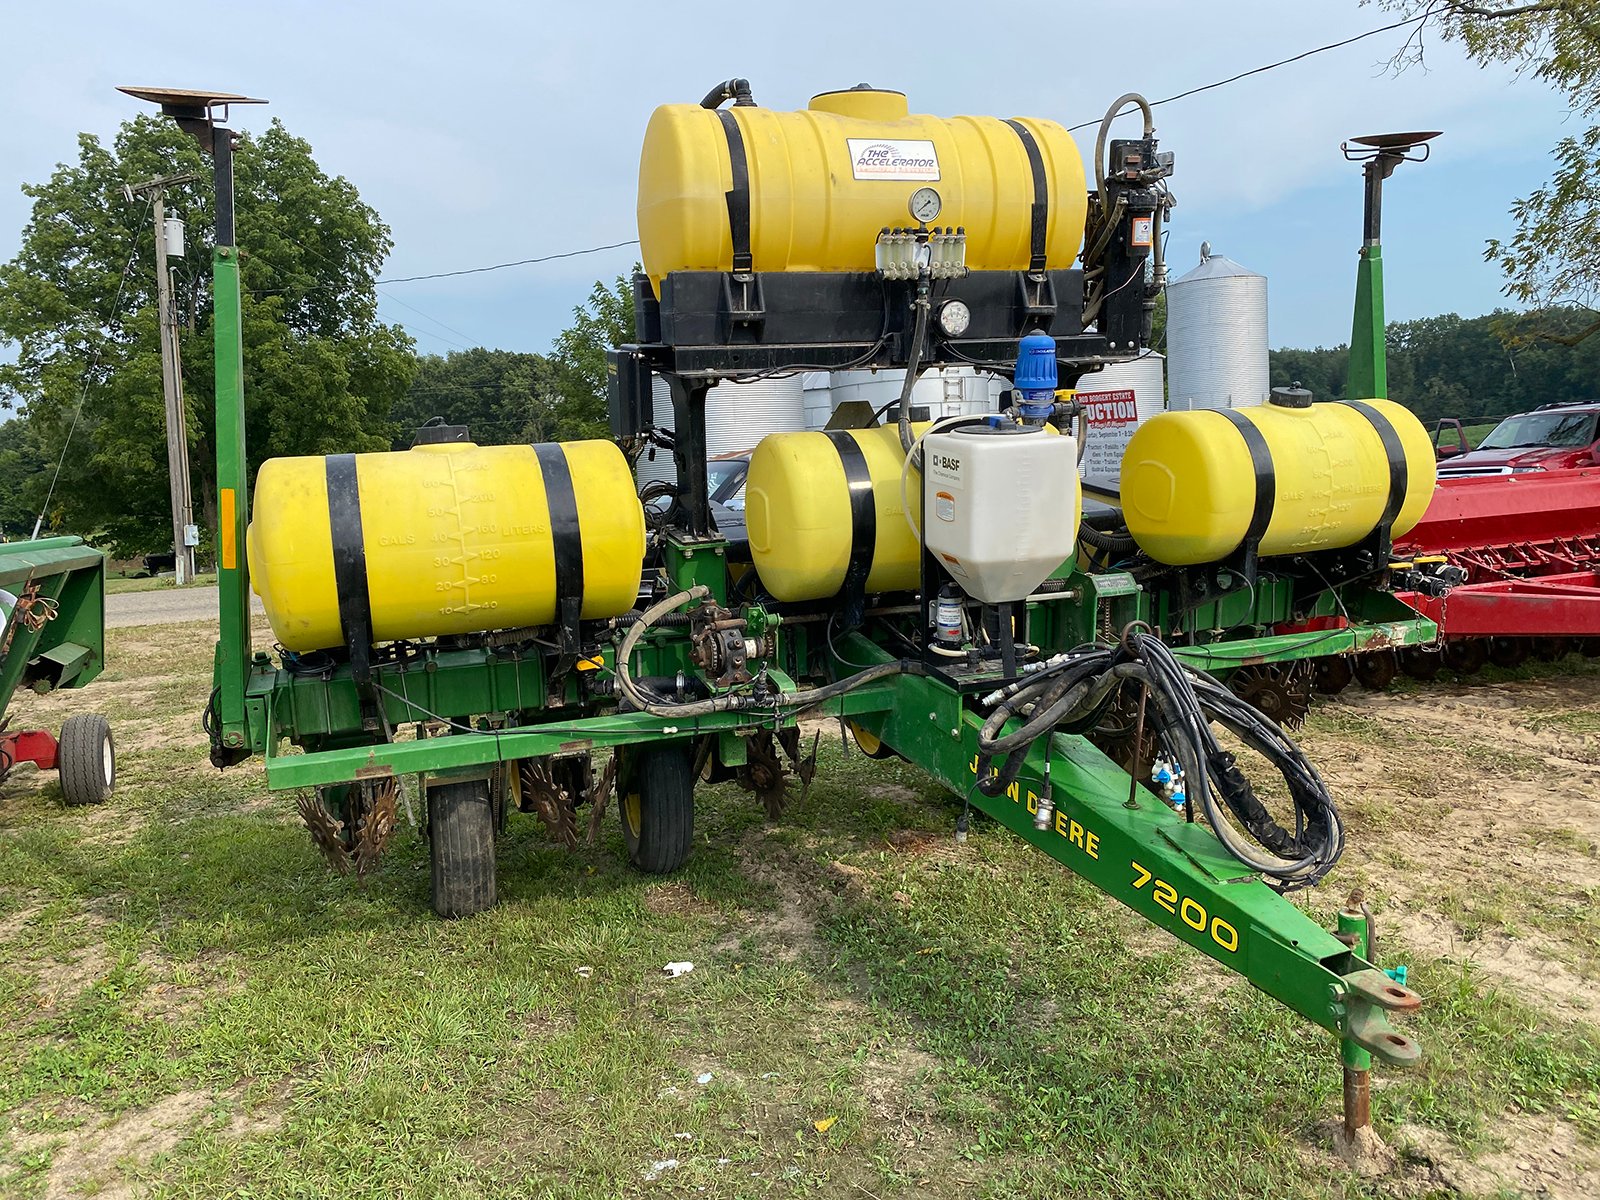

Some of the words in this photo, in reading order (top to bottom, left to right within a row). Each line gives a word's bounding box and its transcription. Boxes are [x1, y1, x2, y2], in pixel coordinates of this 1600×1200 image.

[868, 150, 889, 158] THE
[857, 158, 934, 167] ACCELERATOR
[1112, 392, 1132, 400] ESTATE
[1086, 401, 1135, 420] UCTION
[942, 456, 960, 471] BASF
[427, 507, 445, 517] 50
[477, 524, 497, 534] 160
[502, 523, 546, 537] LITERS
[378, 535, 416, 547] GALS
[479, 549, 501, 560] 120
[433, 556, 451, 568] 30
[480, 574, 498, 584] 80
[436, 581, 453, 592] 20
[481, 600, 498, 609] 40
[439, 607, 453, 615] 10
[1027, 790, 1100, 861] DERE
[1130, 860, 1239, 953] 7200
